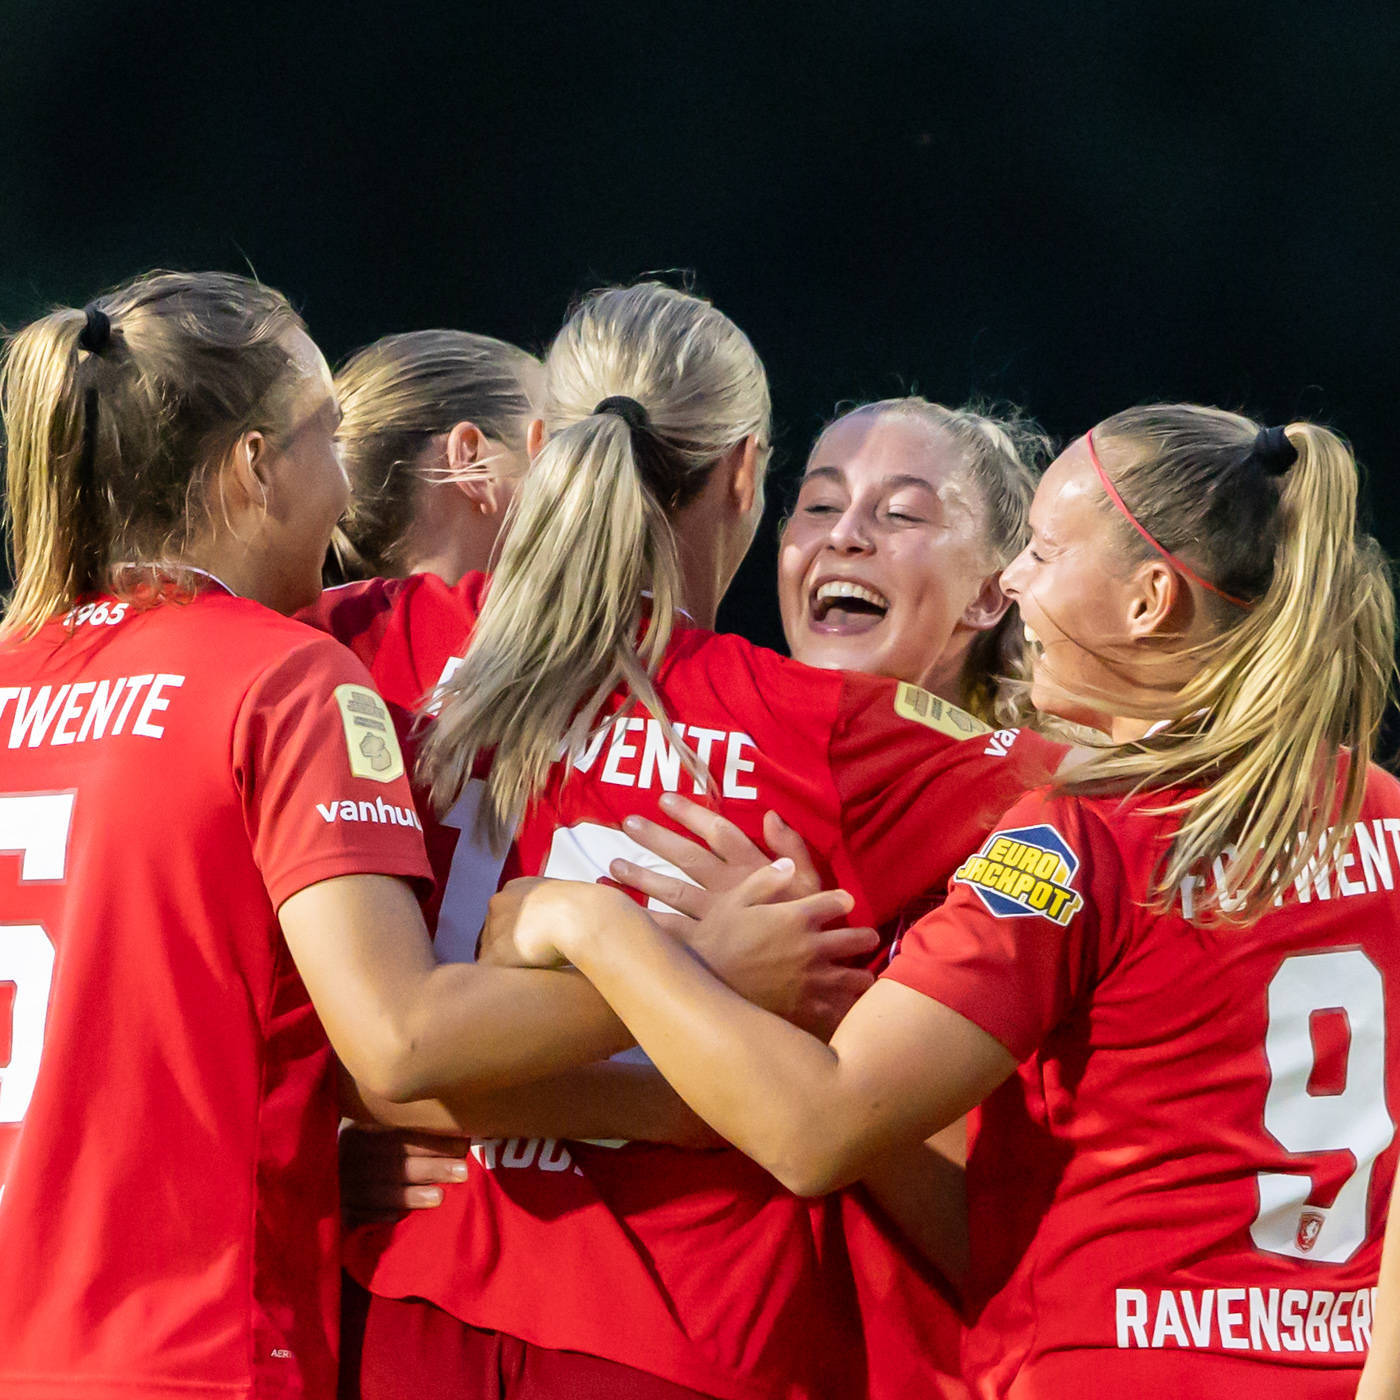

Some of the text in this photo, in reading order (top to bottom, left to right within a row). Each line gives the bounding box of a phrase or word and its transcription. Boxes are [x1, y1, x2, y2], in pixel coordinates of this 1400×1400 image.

[956, 857, 1072, 918] JACKPOT
[987, 837, 1061, 881] EURO
[1250, 947, 1395, 1264] 9
[1116, 1287, 1378, 1352] RAVENSBER
